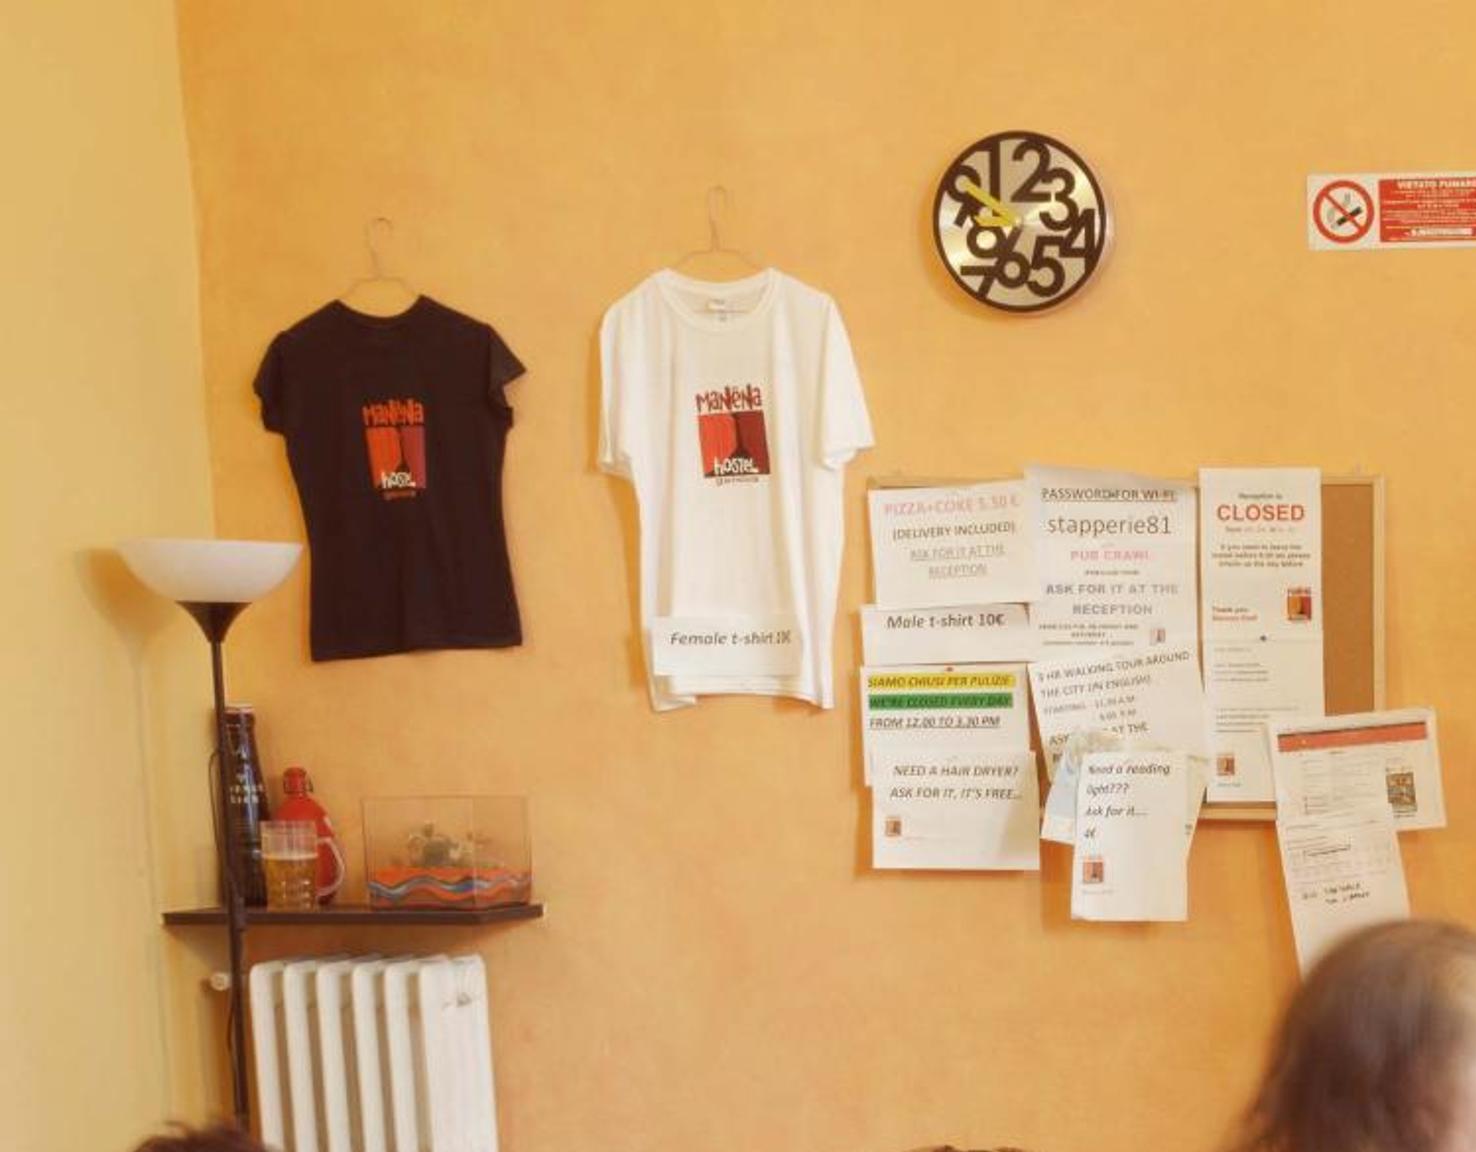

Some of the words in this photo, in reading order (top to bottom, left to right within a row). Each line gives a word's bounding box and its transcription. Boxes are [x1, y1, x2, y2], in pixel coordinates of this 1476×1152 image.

[1027, 236, 1066, 297] 5
[1216, 503, 1305, 522] CLOSED
[1047, 515, 1172, 538] stapperie81
[1046, 583, 1074, 595] ASK
[1078, 583, 1105, 595] FOR
[1110, 583, 1123, 595] IT
[1128, 583, 1146, 595] AT
[1152, 583, 1179, 595] THE
[1072, 603, 1153, 616] RECEPTION
[887, 614, 925, 629] Male
[929, 613, 974, 628] t-shirt
[979, 612, 1007, 627] 10€
[670, 630, 728, 646] Female
